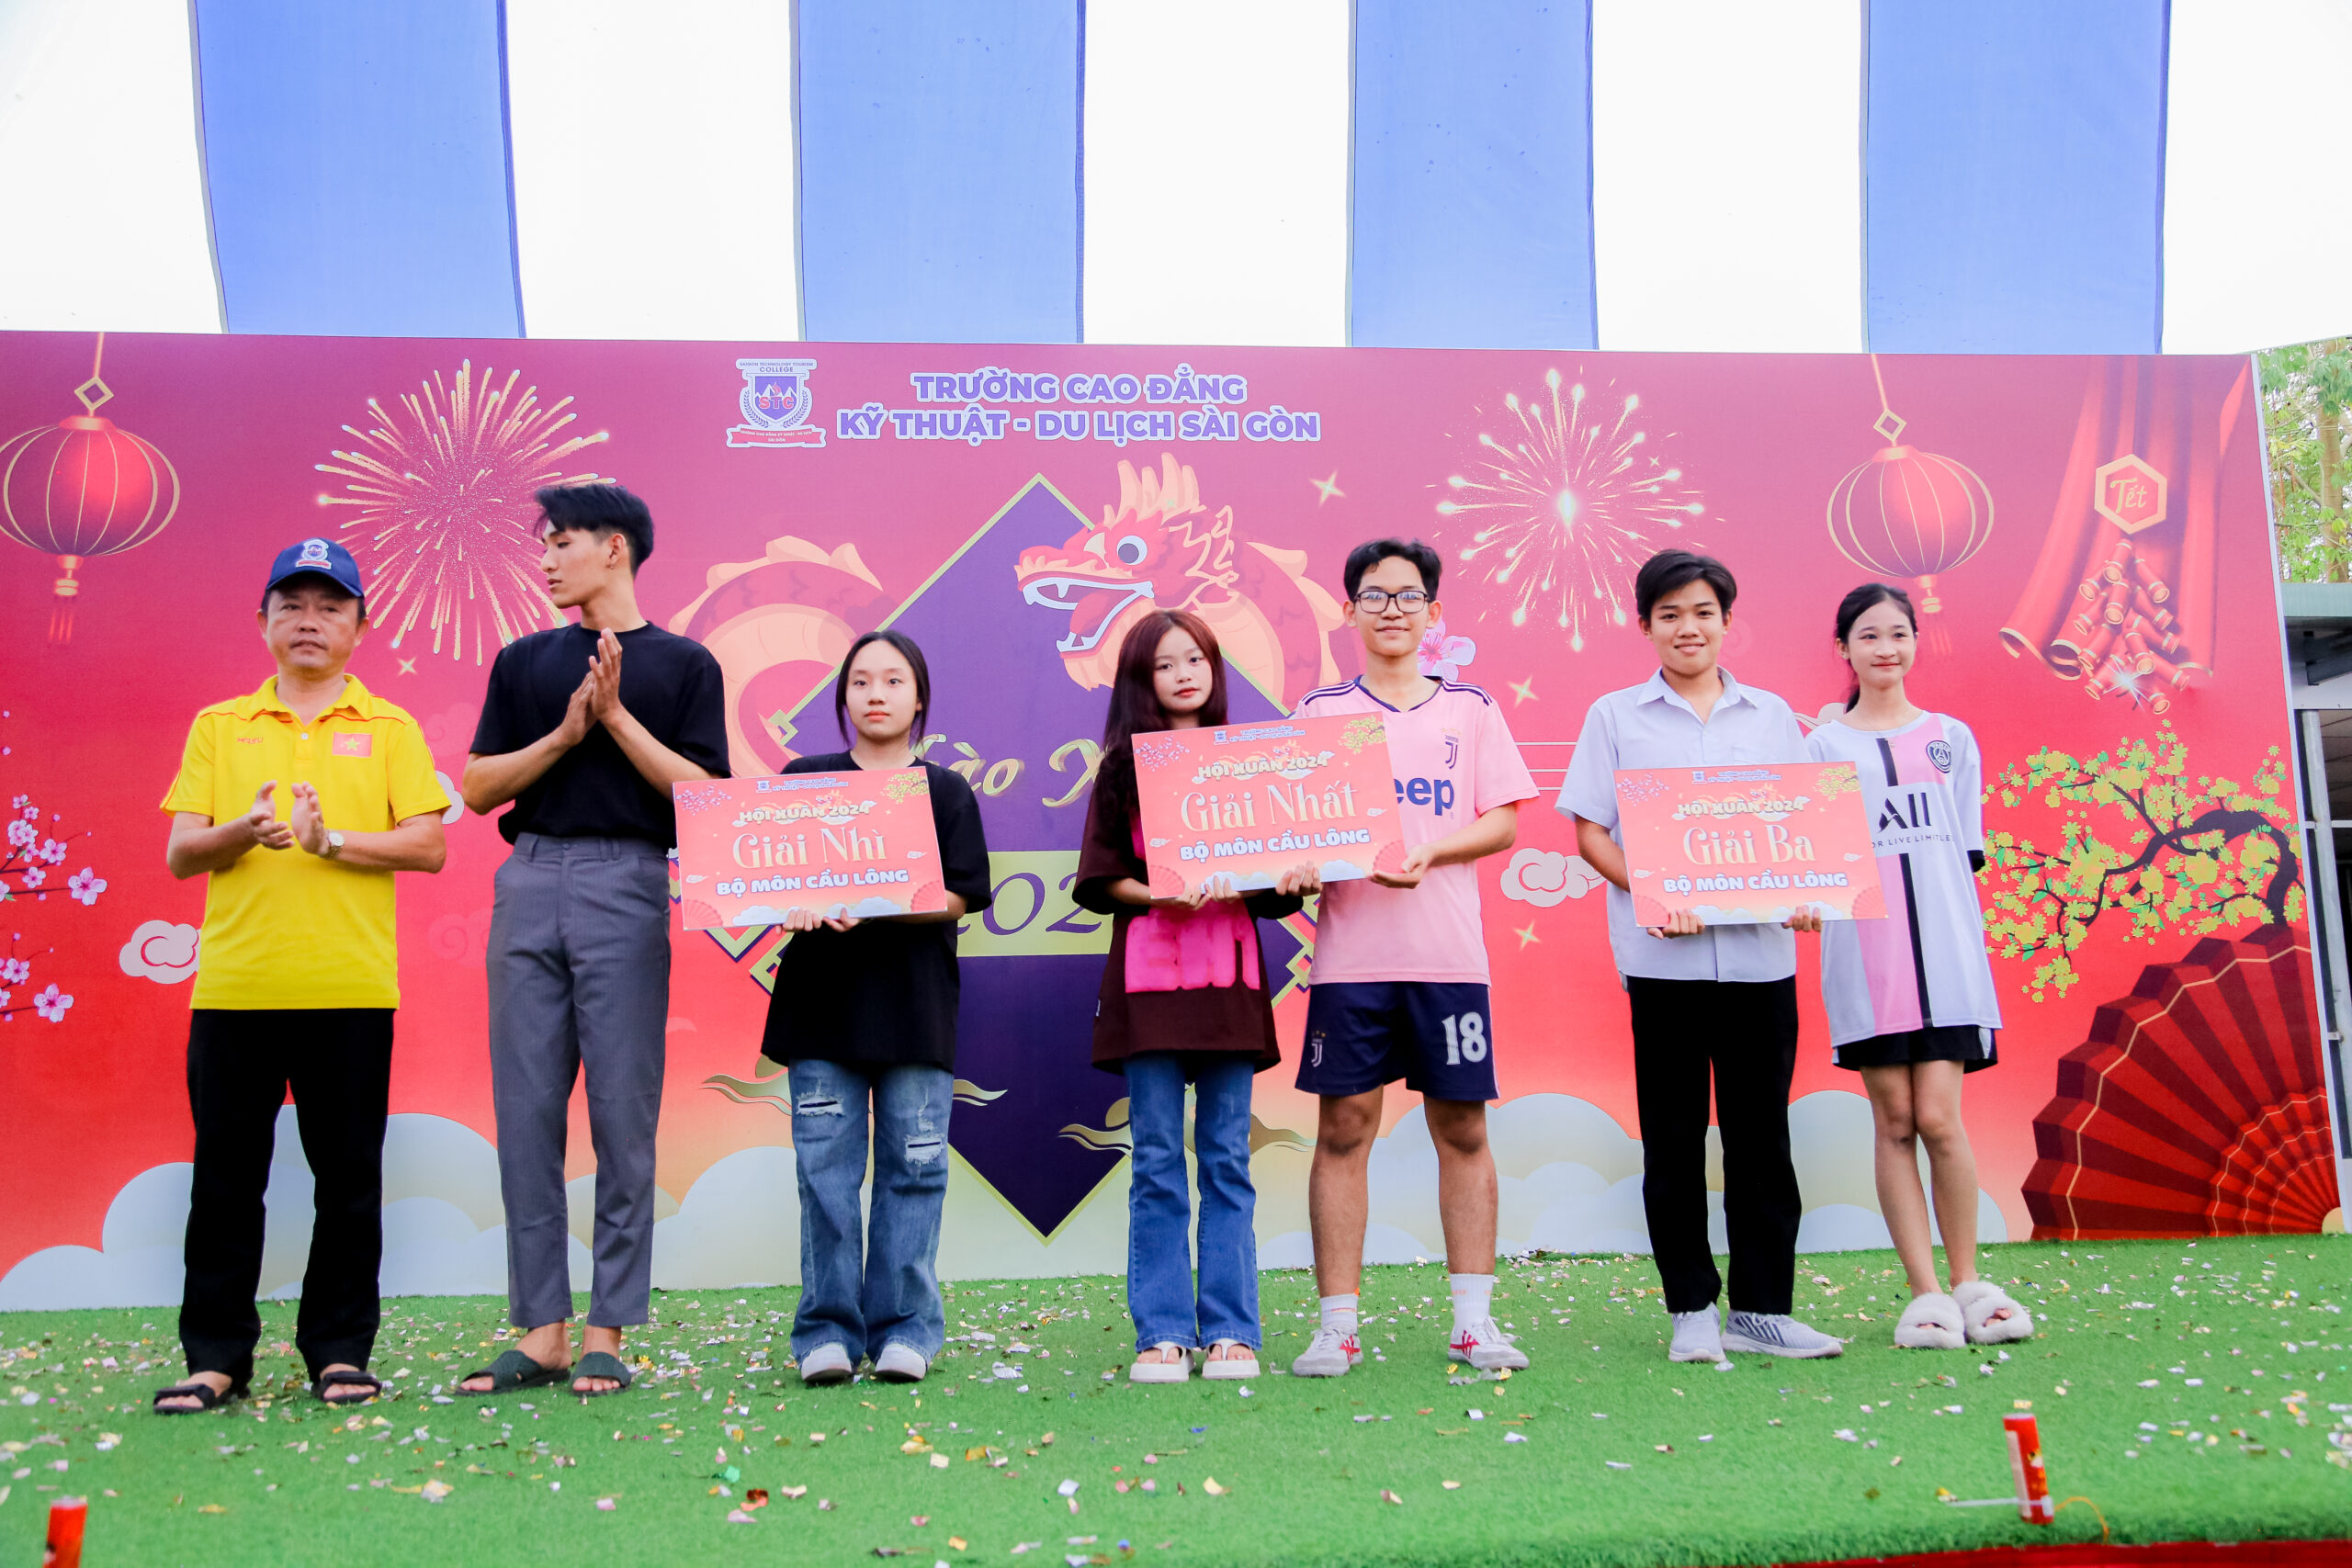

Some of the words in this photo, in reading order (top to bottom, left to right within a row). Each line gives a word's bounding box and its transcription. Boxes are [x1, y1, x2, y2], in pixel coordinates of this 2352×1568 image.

[912, 368, 1057, 400] TRƯỜNG
[1065, 375, 1139, 401] CAO
[1146, 366, 1245, 402] ĐẲNG
[758, 396, 795, 410] STC
[839, 405, 886, 437] KỸ
[891, 405, 1008, 444] THUẬT
[1037, 412, 1087, 438] DU
[1096, 412, 1173, 445] LỊCH
[1181, 406, 1237, 438] SÀI
[1245, 407, 1318, 440] GÒN
[2109, 477, 2147, 514] Tết
[1197, 762, 1230, 781] HỘI
[1233, 757, 1283, 776] XUÂN
[1286, 755, 1329, 770] 2024
[739, 807, 771, 825] HỘI
[774, 803, 826, 822] XUÂN
[828, 802, 871, 818] 2024
[1180, 791, 1258, 832] Giải
[1266, 780, 1358, 825] Nhất
[1677, 802, 1710, 818] HỘI
[1712, 798, 1761, 816] XUÂN
[1763, 799, 1805, 813] 2024
[731, 832, 809, 869] Giải
[819, 826, 887, 863] Nhì
[1179, 840, 1210, 863] BỘ
[1213, 836, 1264, 858] MÔN
[1266, 829, 1311, 852] CẦU
[1314, 828, 1372, 848] LÔNG
[1682, 827, 1758, 866] Giải
[1765, 824, 1816, 863] Ba
[1888, 836, 1912, 846] LIVE
[715, 878, 747, 898] BỘ
[750, 874, 802, 894] MÔN
[805, 868, 850, 889] CẦU
[852, 868, 910, 887] LÔNG
[1662, 874, 1692, 897] BỘ
[1695, 873, 1745, 892] MÔN
[1747, 868, 1790, 889] CẦU
[1792, 870, 1849, 888] LÔNG
[1442, 1011, 1487, 1066] 18
